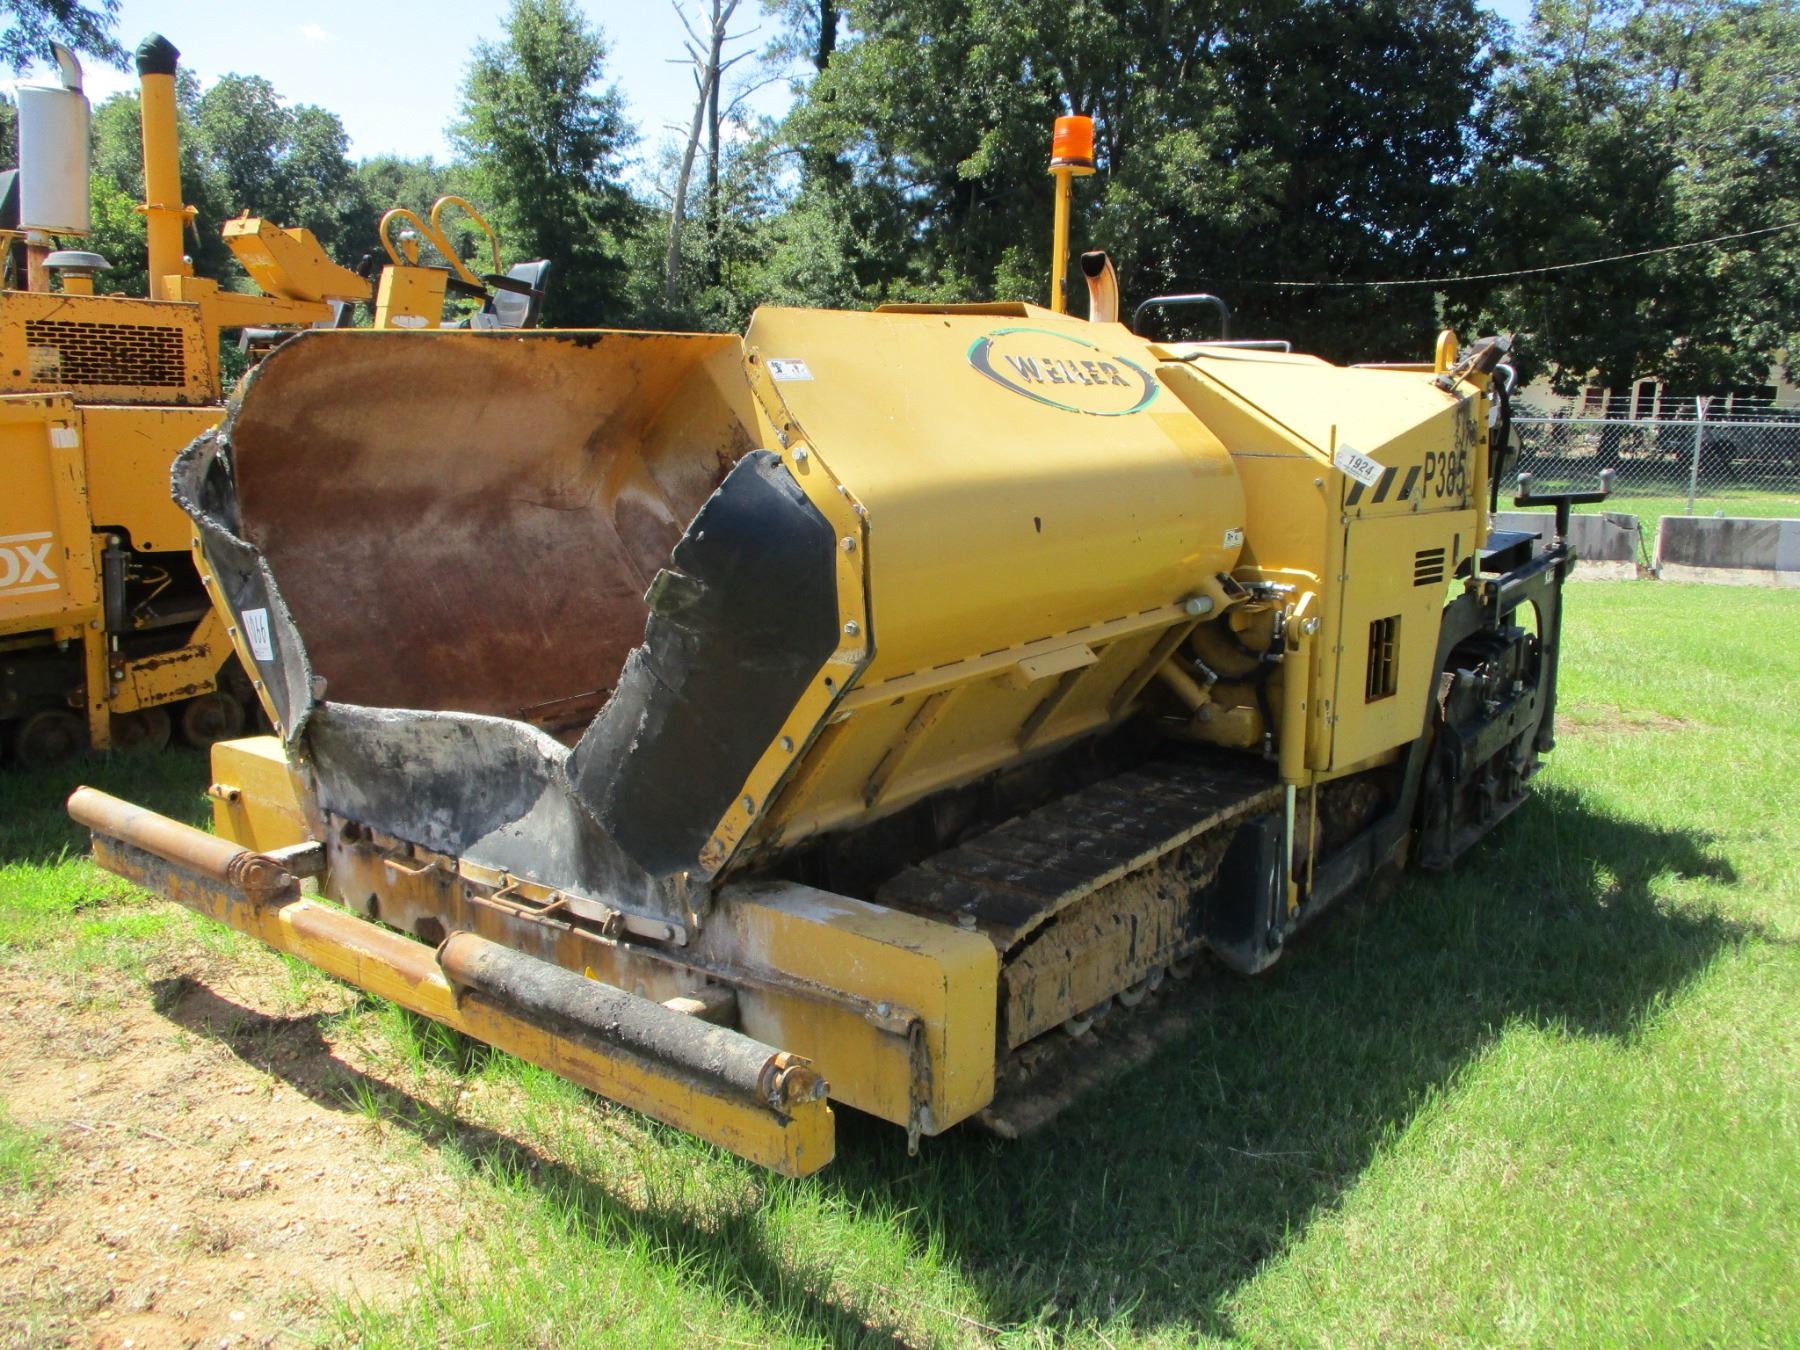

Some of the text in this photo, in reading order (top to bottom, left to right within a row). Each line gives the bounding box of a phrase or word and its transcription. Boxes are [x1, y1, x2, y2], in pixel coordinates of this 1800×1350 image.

[1004, 355, 1131, 386] WEILER
[1349, 455, 1375, 476] 1924
[1422, 450, 1467, 498] P385
